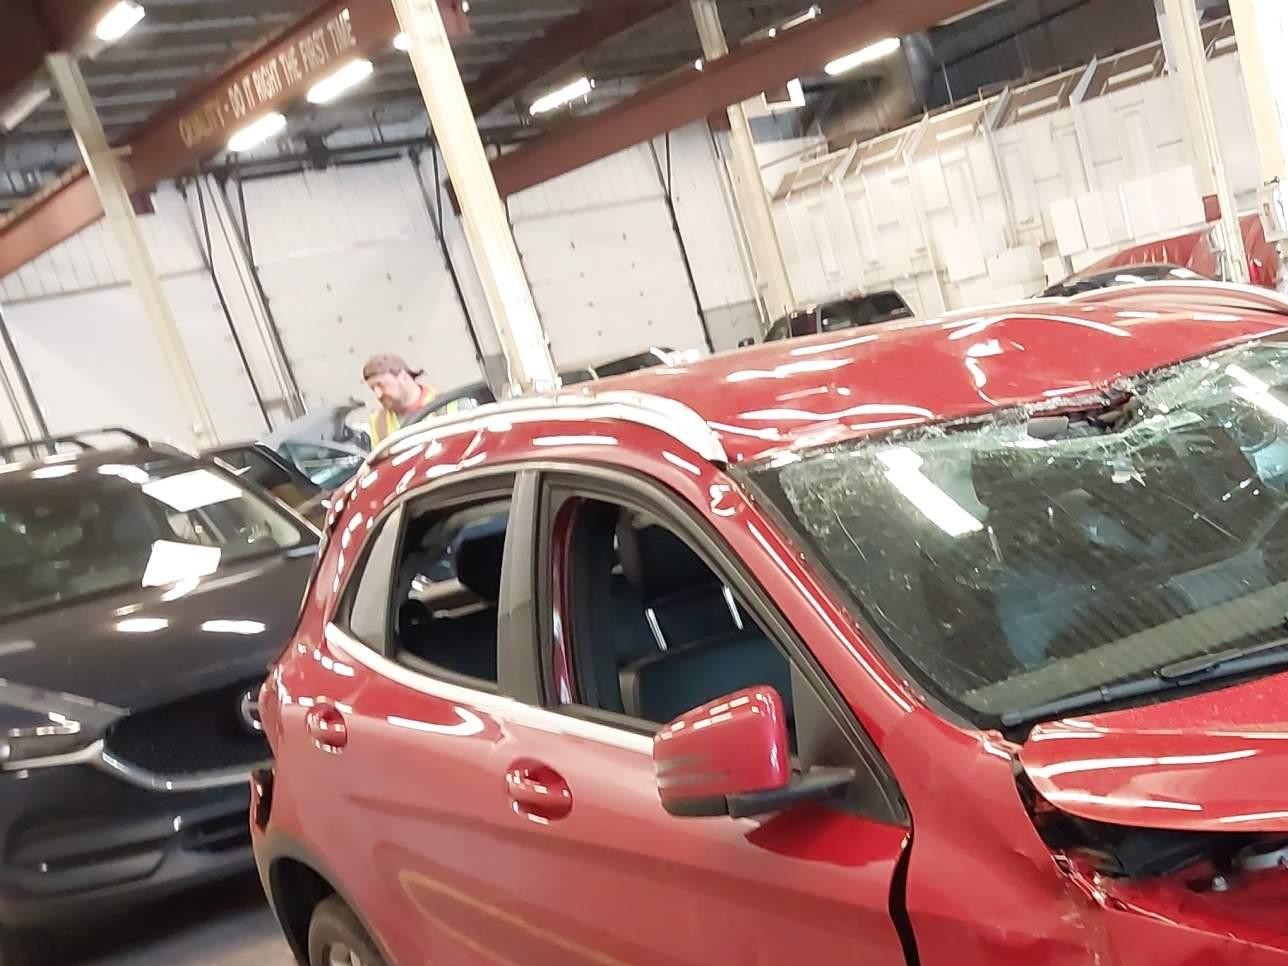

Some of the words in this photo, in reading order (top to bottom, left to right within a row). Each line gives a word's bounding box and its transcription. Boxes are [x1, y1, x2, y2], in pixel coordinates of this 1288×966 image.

[228, 82, 246, 119] DO
[241, 75, 256, 111] IT
[252, 57, 283, 103] RIGHT
[278, 47, 303, 87] THE
[299, 27, 330, 73] FIRST
